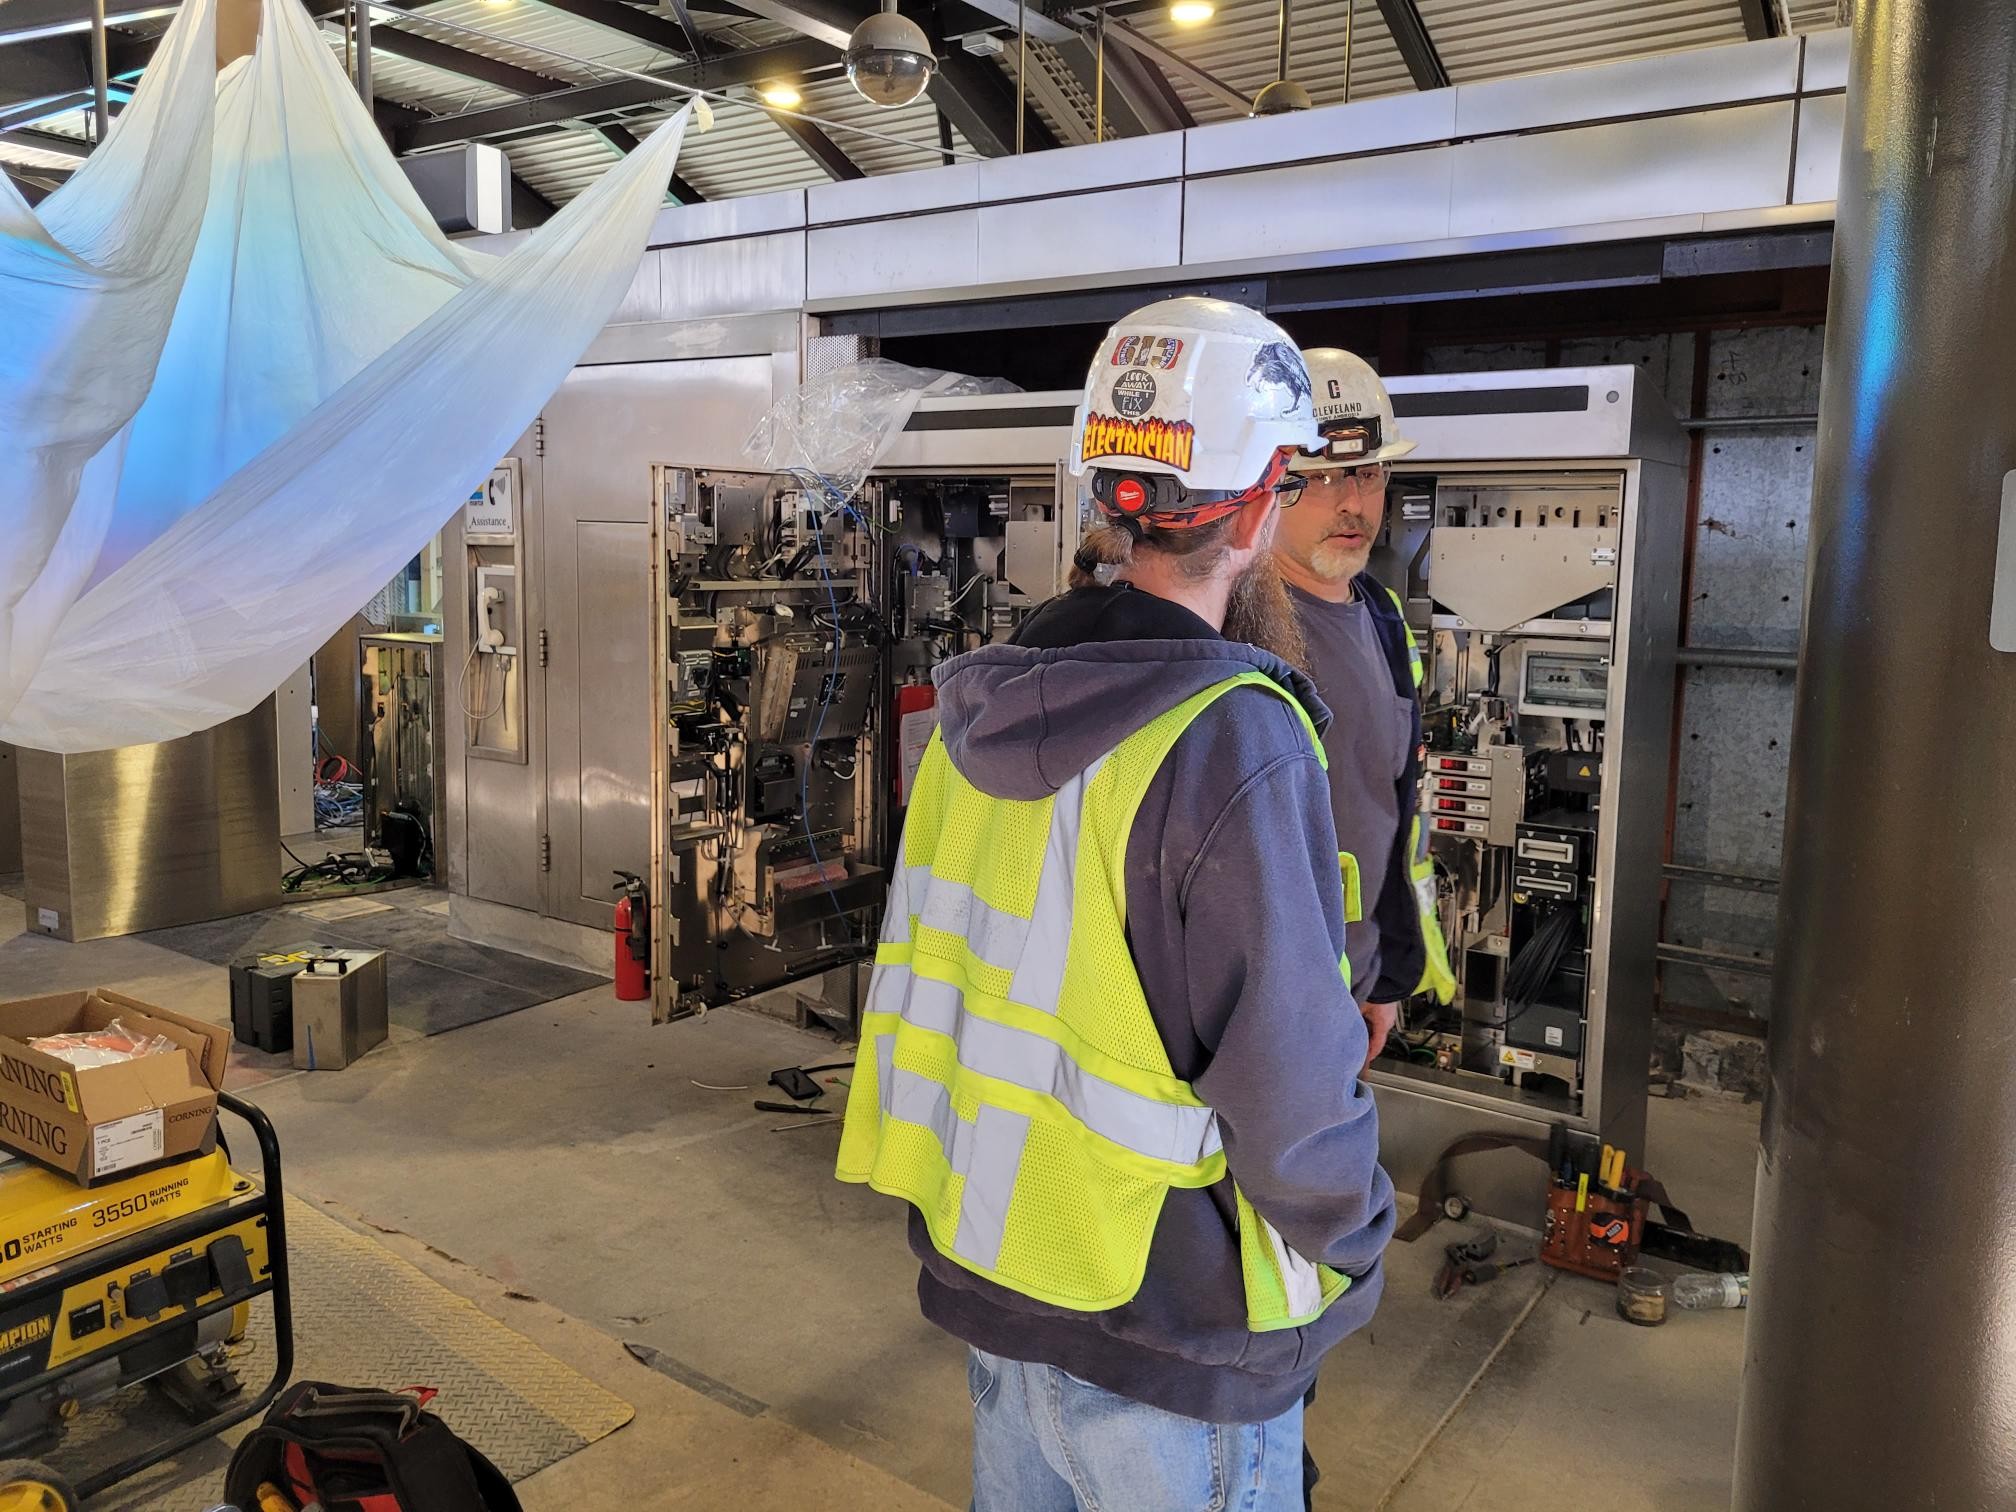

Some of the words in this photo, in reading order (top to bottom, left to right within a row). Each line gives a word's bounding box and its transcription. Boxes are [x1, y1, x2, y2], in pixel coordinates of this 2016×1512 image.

[1126, 373, 1149, 382] LOOK
[1122, 397, 1142, 411] FIX
[1312, 402, 1362, 417] CLEVELAND
[1081, 411, 1194, 472] ELECTRICIAN
[471, 516, 507, 527] Assistance
[168, 1107, 213, 1124] CORNING
[149, 1178, 189, 1199] RUNNING
[92, 1193, 148, 1228] 3550
[150, 1190, 181, 1207] WATTS
[22, 1217, 78, 1244] STARTING
[0, 1238, 21, 1264] 0
[24, 1233, 63, 1255] WATTS
